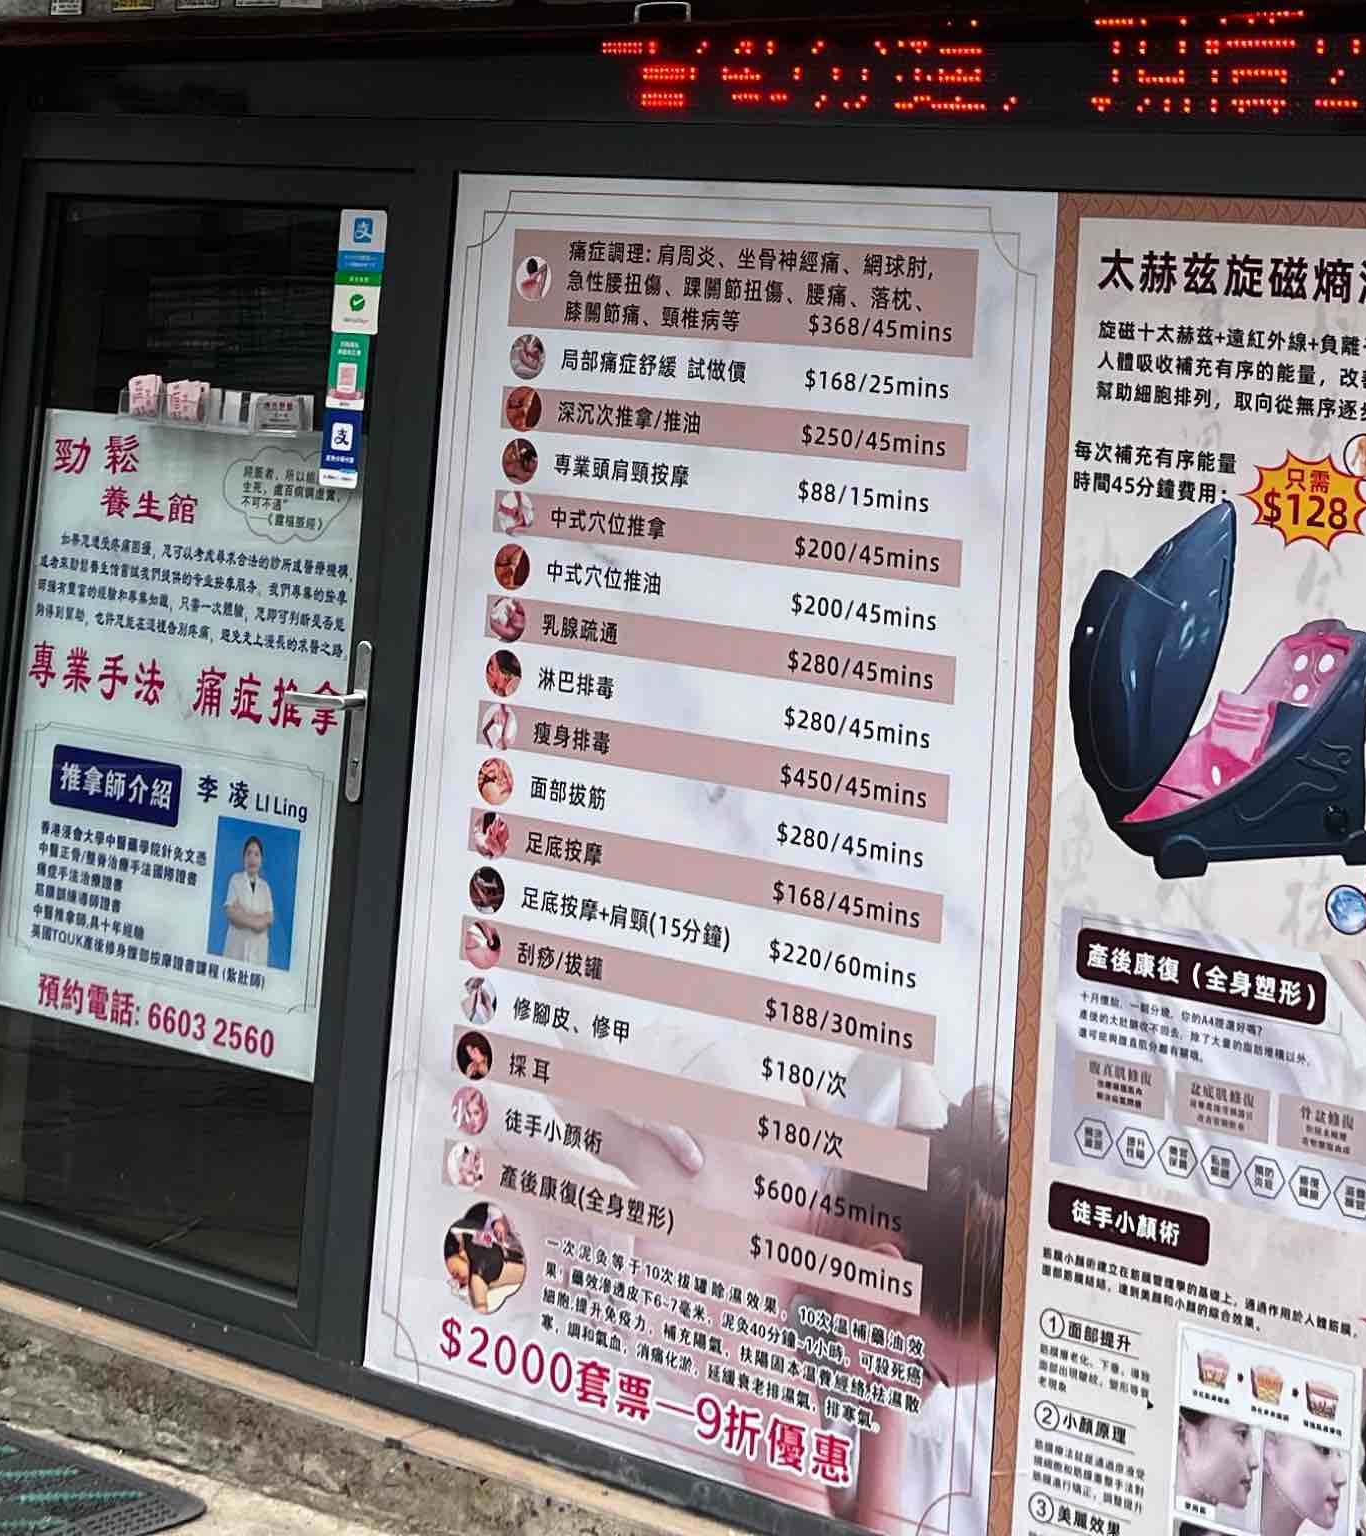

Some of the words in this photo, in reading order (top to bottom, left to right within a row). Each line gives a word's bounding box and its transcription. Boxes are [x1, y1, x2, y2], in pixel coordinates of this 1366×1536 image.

[807, 313, 954, 345] $368/45mins
[560, 347, 677, 380] 局部痛症舒緩
[686, 355, 747, 385] 試做價
[803, 367, 951, 401] $168/25mins
[51, 432, 142, 476] 勁鬆
[800, 423, 948, 459] $250/45mins
[1073, 440, 1237, 475] 每次補充有序能量
[797, 479, 931, 515] $88/15mins
[1285, 465, 1331, 494] 只需
[99, 483, 200, 527] 養生館
[549, 506, 667, 541] 中式穴位推拿
[1261, 486, 1349, 531] $128
[793, 536, 942, 574] $200/45mins
[545, 560, 663, 596] 中式穴位推油
[540, 611, 620, 646] 乳腺疏通
[789, 592, 938, 633] $200/45mins
[29, 645, 165, 708] 專業手法
[537, 664, 616, 702] 淋巴排毒
[786, 649, 935, 692] $280/45mins
[532, 719, 612, 757] 瘦身排毒
[782, 705, 932, 751] $280/45mins
[58, 760, 175, 811] 推拿師介紹
[273, 793, 309, 825] Ling
[529, 774, 607, 812] 面部拔筋
[779, 763, 928, 811] $450/45mins
[524, 830, 605, 867] 足底按摩
[775, 820, 926, 870] $280/45mins
[771, 880, 922, 930] $168/45mins
[516, 940, 605, 982] 刮痧/拔罐
[768, 938, 918, 991] $220/60mins
[147, 1001, 207, 1042] 6603
[212, 1016, 276, 1059] 2560
[764, 997, 915, 1051] $188/30mins
[760, 1056, 848, 1099] $180/次
[757, 1114, 845, 1159] $180/次
[752, 1174, 904, 1234] $600/45mins
[748, 1234, 915, 1300] $1000/90mins
[1066, 1320, 1132, 1353] 面部提升
